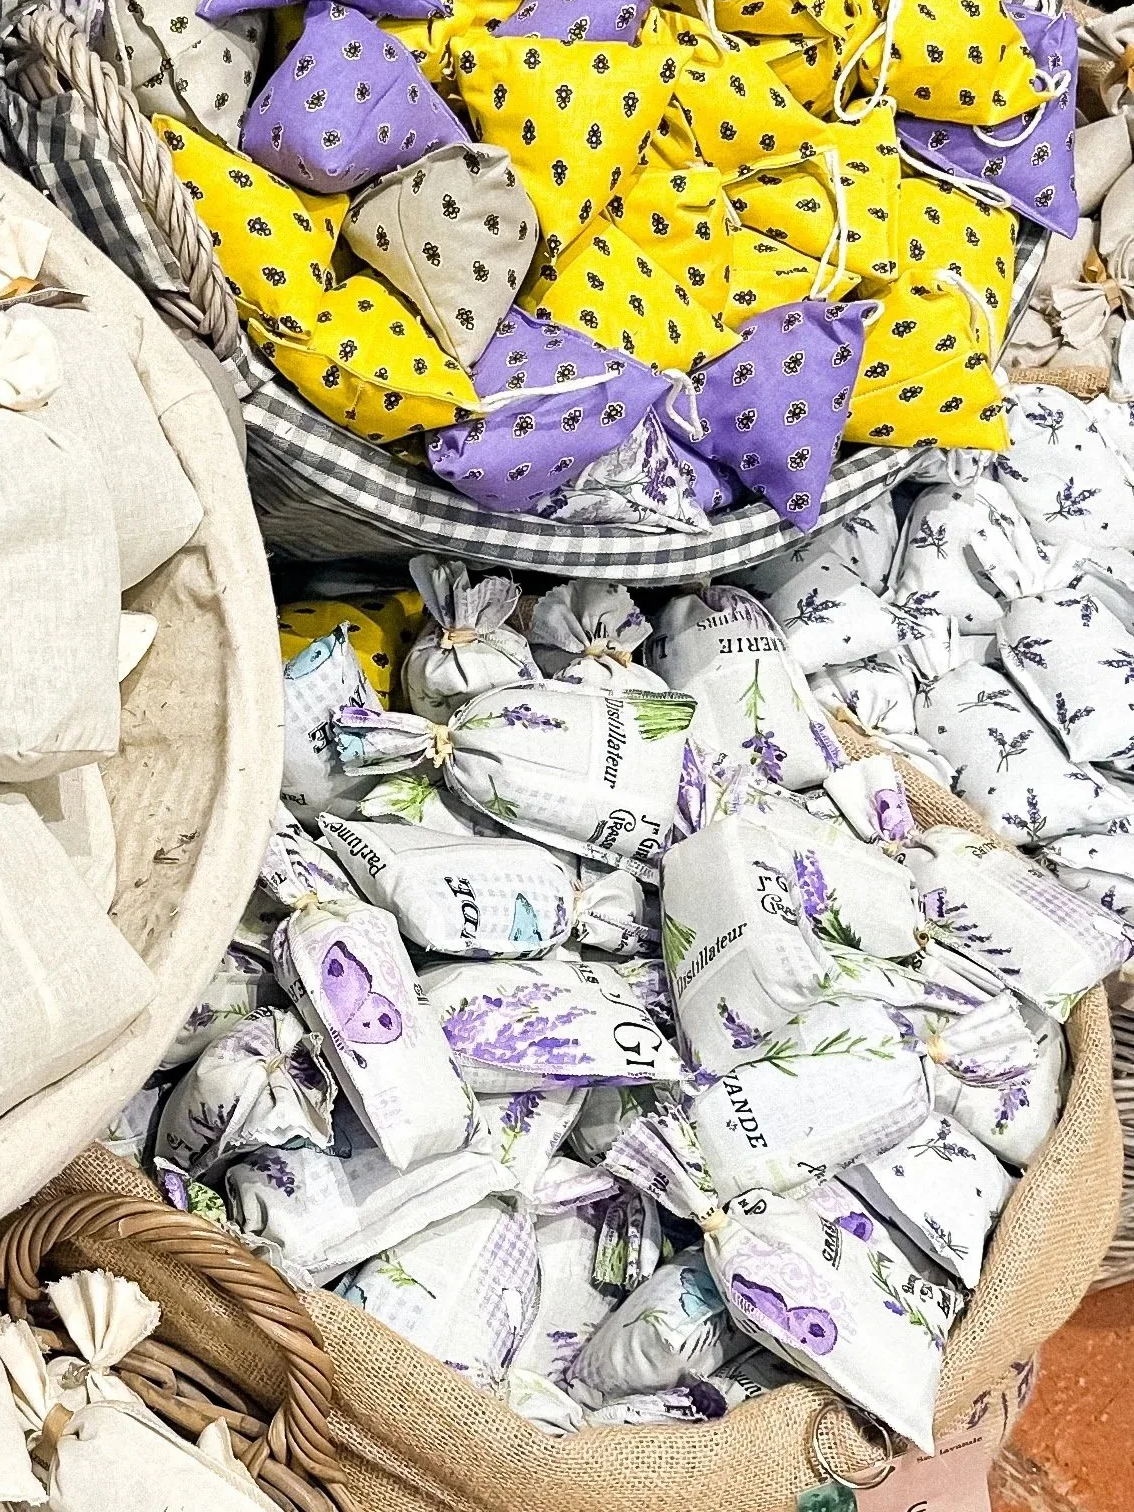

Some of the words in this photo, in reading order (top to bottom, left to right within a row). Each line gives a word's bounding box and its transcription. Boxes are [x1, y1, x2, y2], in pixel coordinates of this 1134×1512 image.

[604, 696, 626, 789] Distillateur
[323, 815, 387, 878] Parfumer
[676, 922, 748, 999] Distillateur
[613, 1021, 663, 1068] GI
[722, 1068, 768, 1149] VANDE
